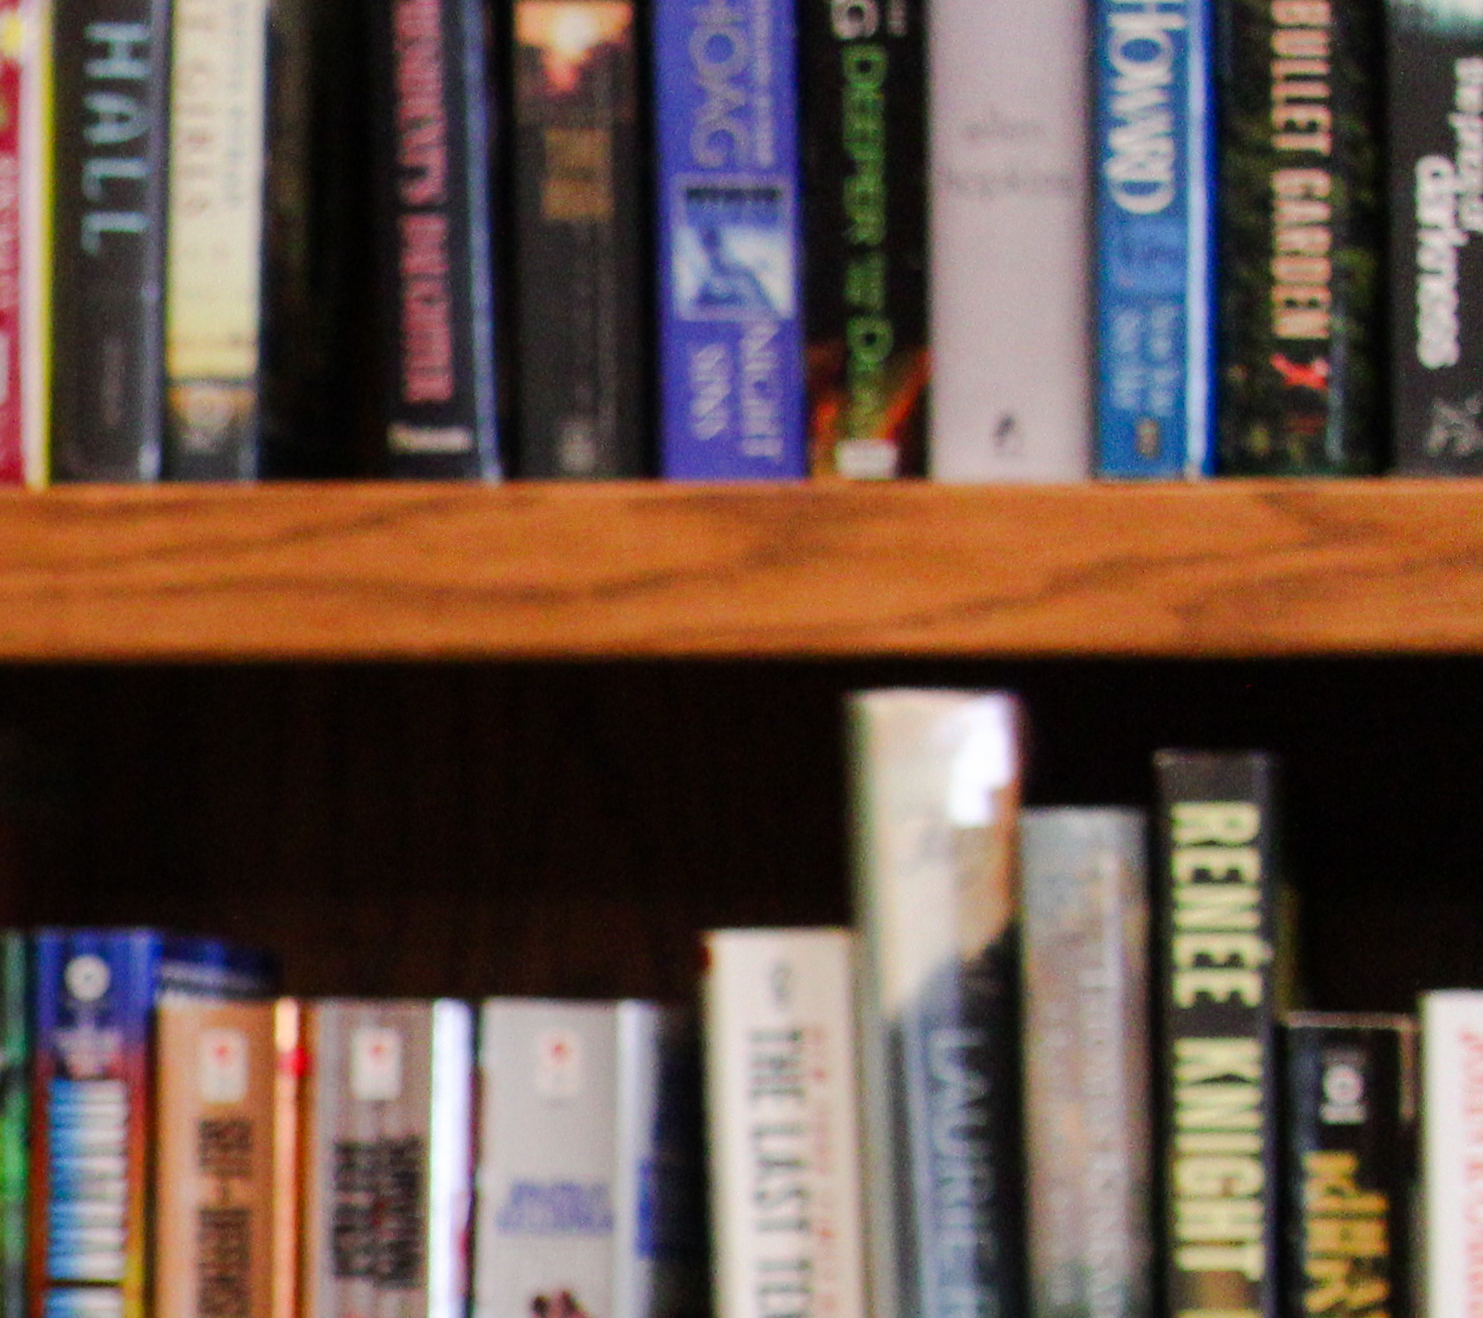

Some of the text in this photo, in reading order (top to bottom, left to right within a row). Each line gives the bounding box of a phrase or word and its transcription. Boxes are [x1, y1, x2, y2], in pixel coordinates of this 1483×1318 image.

[82, 21, 151, 257] HALL
[1271, 0, 1333, 341] BULLET GARDEN
[1415, 154, 1470, 370] darkness
[1171, 800, 1276, 1008] RENÉE
[748, 1028, 808, 1107] THE
[1173, 1038, 1267, 1283] KNIGHT
[753, 1120, 812, 1237] LAST
